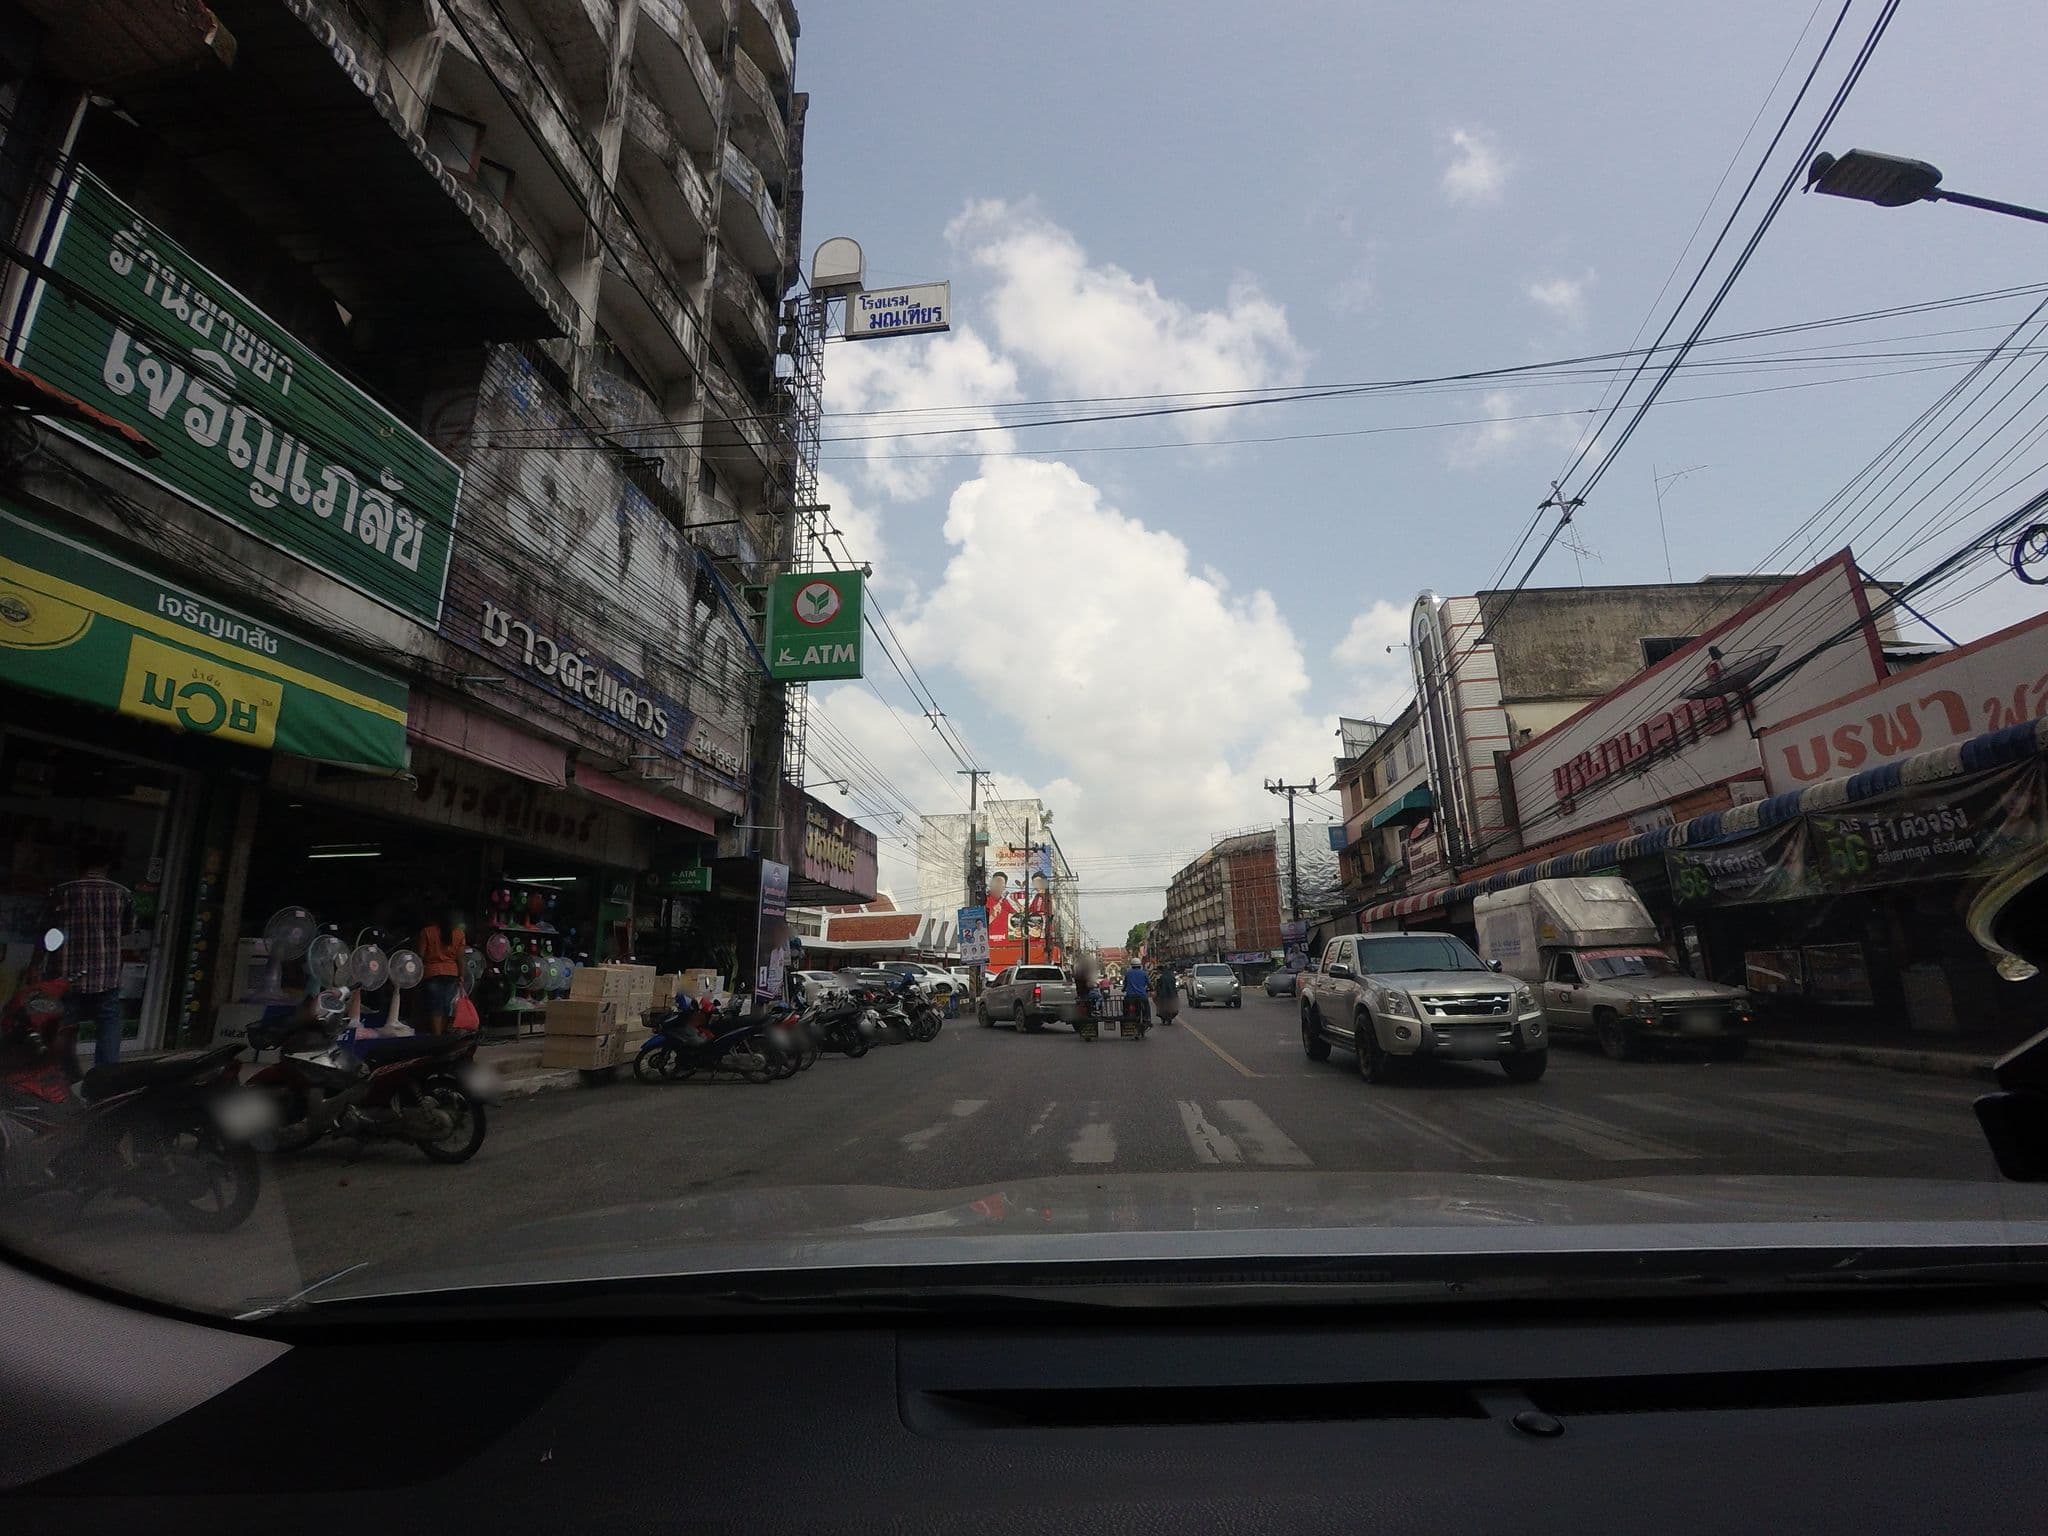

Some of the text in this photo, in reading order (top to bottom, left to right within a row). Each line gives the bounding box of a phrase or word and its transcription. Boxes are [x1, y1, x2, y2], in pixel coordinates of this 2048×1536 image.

[109, 220, 293, 395] ร้านขายยา
[859, 294, 909, 310] โรงแรม
[103, 326, 425, 573] เจริญเภสัช
[157, 593, 279, 655] เจริญเภสัช
[802, 643, 856, 665] ATM
[1839, 818, 1861, 834] AIS
